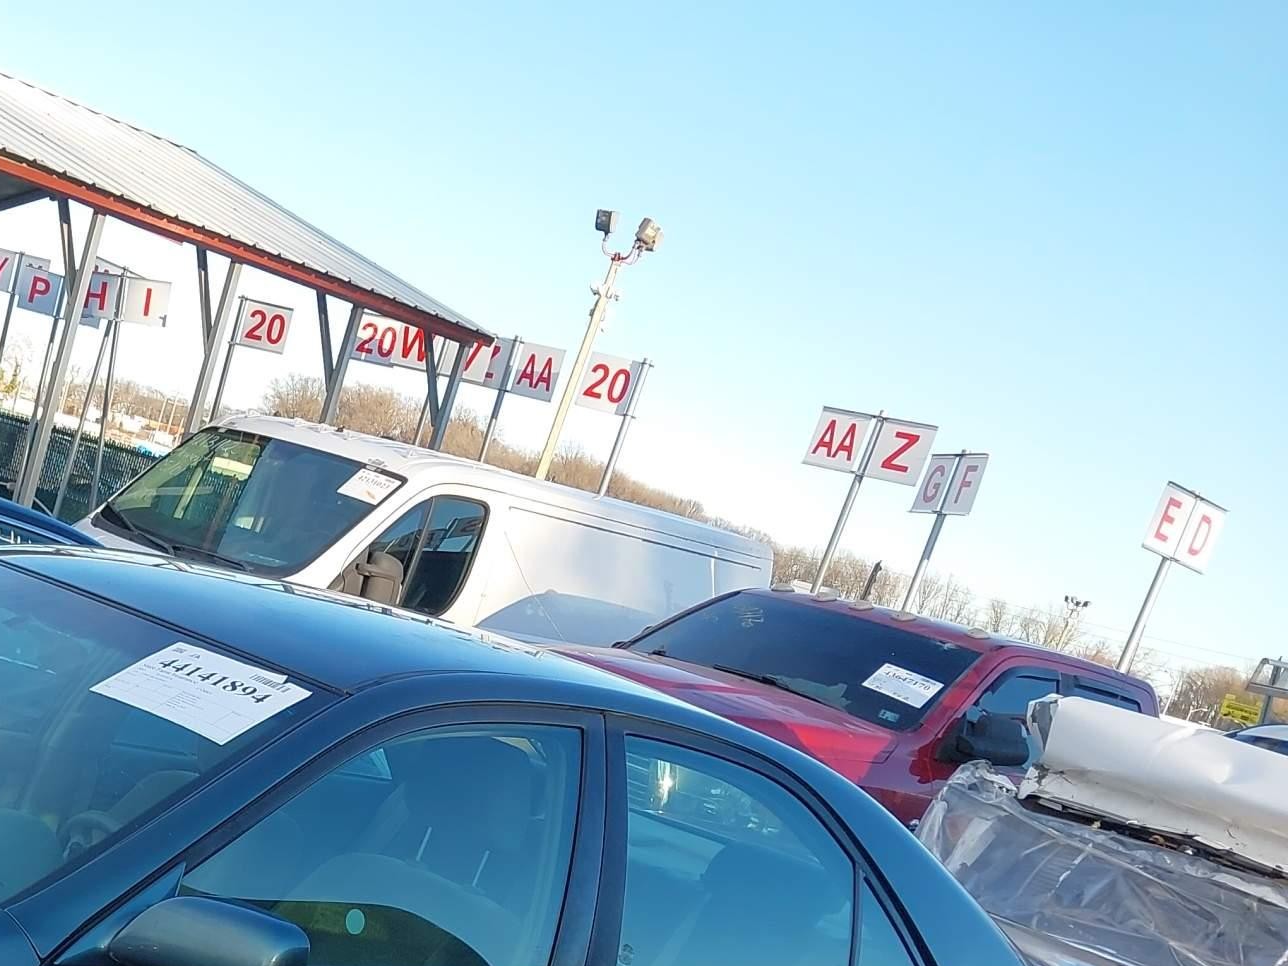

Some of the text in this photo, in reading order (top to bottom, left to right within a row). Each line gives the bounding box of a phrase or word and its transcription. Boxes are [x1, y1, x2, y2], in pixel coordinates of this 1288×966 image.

[27, 275, 51, 304] P
[83, 281, 109, 311] H
[143, 287, 153, 317] I
[244, 309, 286, 345] 20
[355, 322, 398, 358] 20
[515, 352, 554, 393] AA
[582, 363, 631, 404] 20
[811, 419, 857, 462] AA
[880, 431, 921, 473] Z
[922, 464, 946, 504] G
[953, 464, 980, 505] F
[1153, 496, 1183, 543] E
[1187, 513, 1212, 556] D
[159, 658, 273, 704] 44141894
